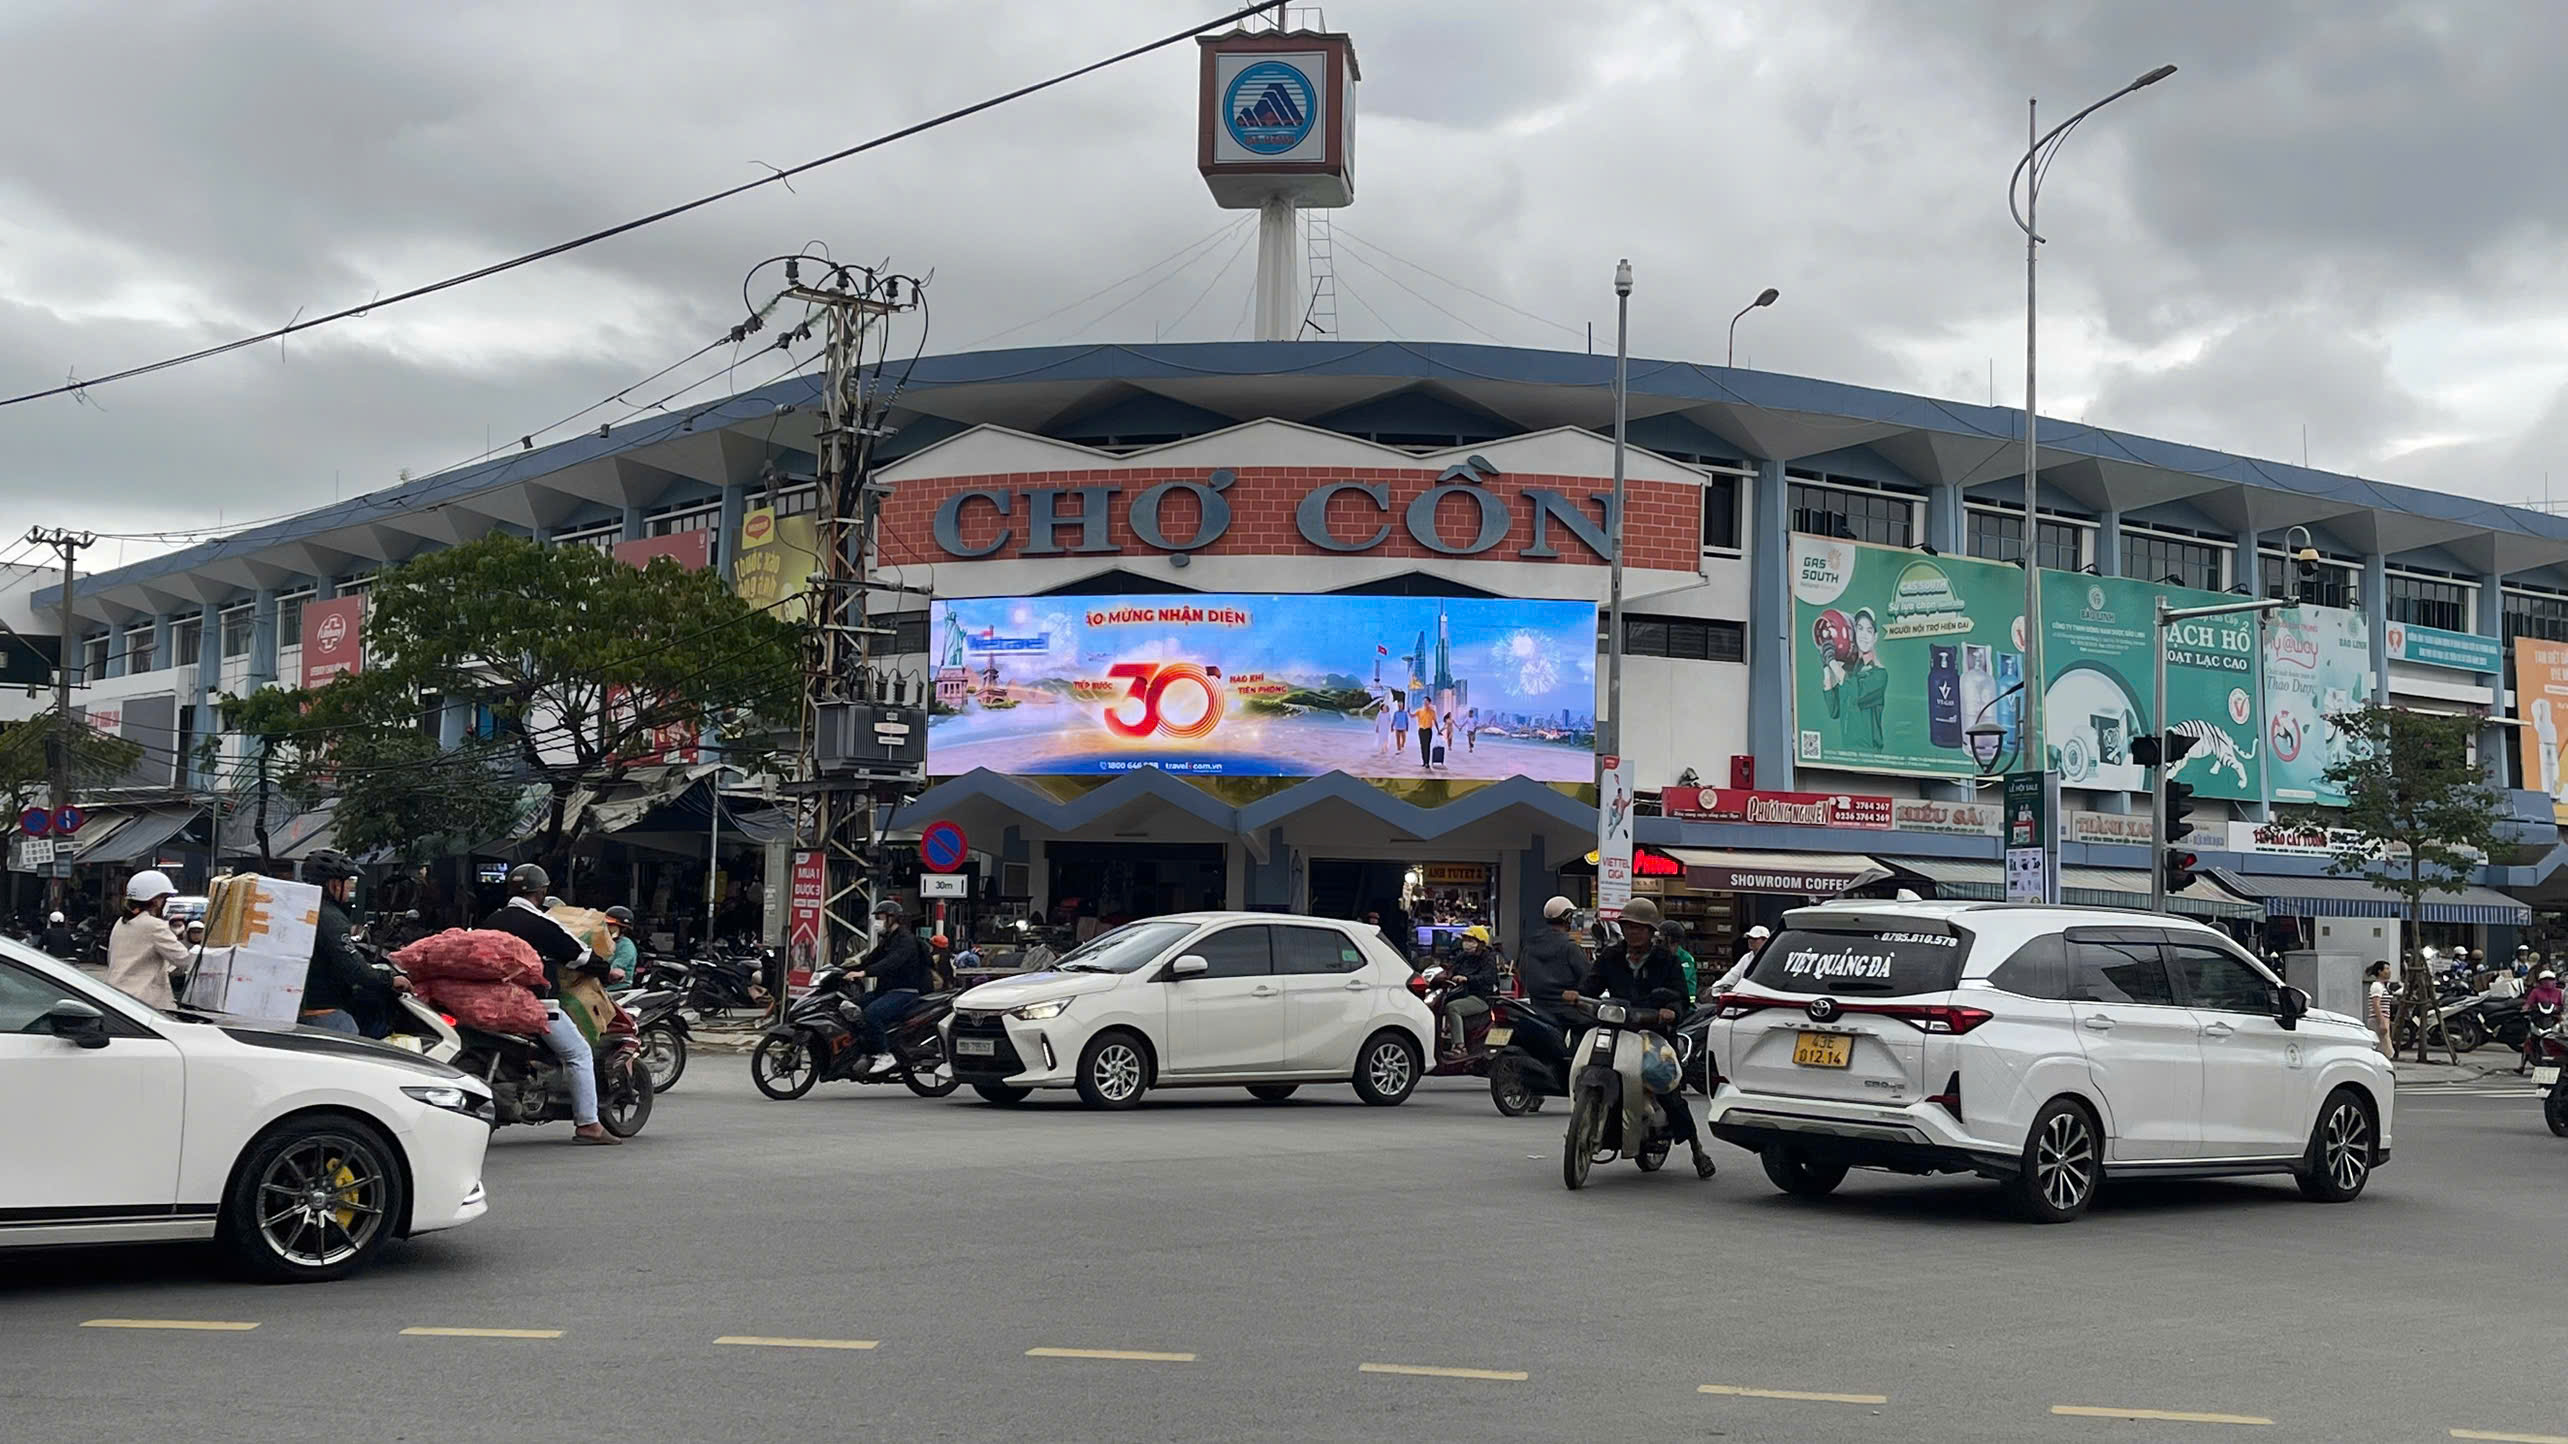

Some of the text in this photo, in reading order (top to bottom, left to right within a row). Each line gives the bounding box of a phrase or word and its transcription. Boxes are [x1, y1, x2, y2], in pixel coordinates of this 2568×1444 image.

[933, 455, 1626, 568] CHỢ CỒN
[1804, 556, 1826, 569] GAS
[1802, 569, 1839, 583] SOUTH
[1108, 608, 1153, 623] MỪNG
[1158, 606, 1203, 626] NHẬN
[1208, 608, 1245, 627] DIỆN
[2167, 622, 2215, 648] ẠCH
[2221, 620, 2251, 652] HỔ
[2167, 650, 2247, 670] OẠT LẠC CAO
[1104, 663, 1224, 739] 30
[936, 881, 953, 889] 30m
[1731, 873, 1849, 890] SHOWROOM COFFEE
[1784, 948, 1819, 977] VIỆT
[1866, 952, 1895, 977] ĐÀ
[1812, 1034, 1836, 1049] 43E
[1800, 1049, 1842, 1064] 012.14
